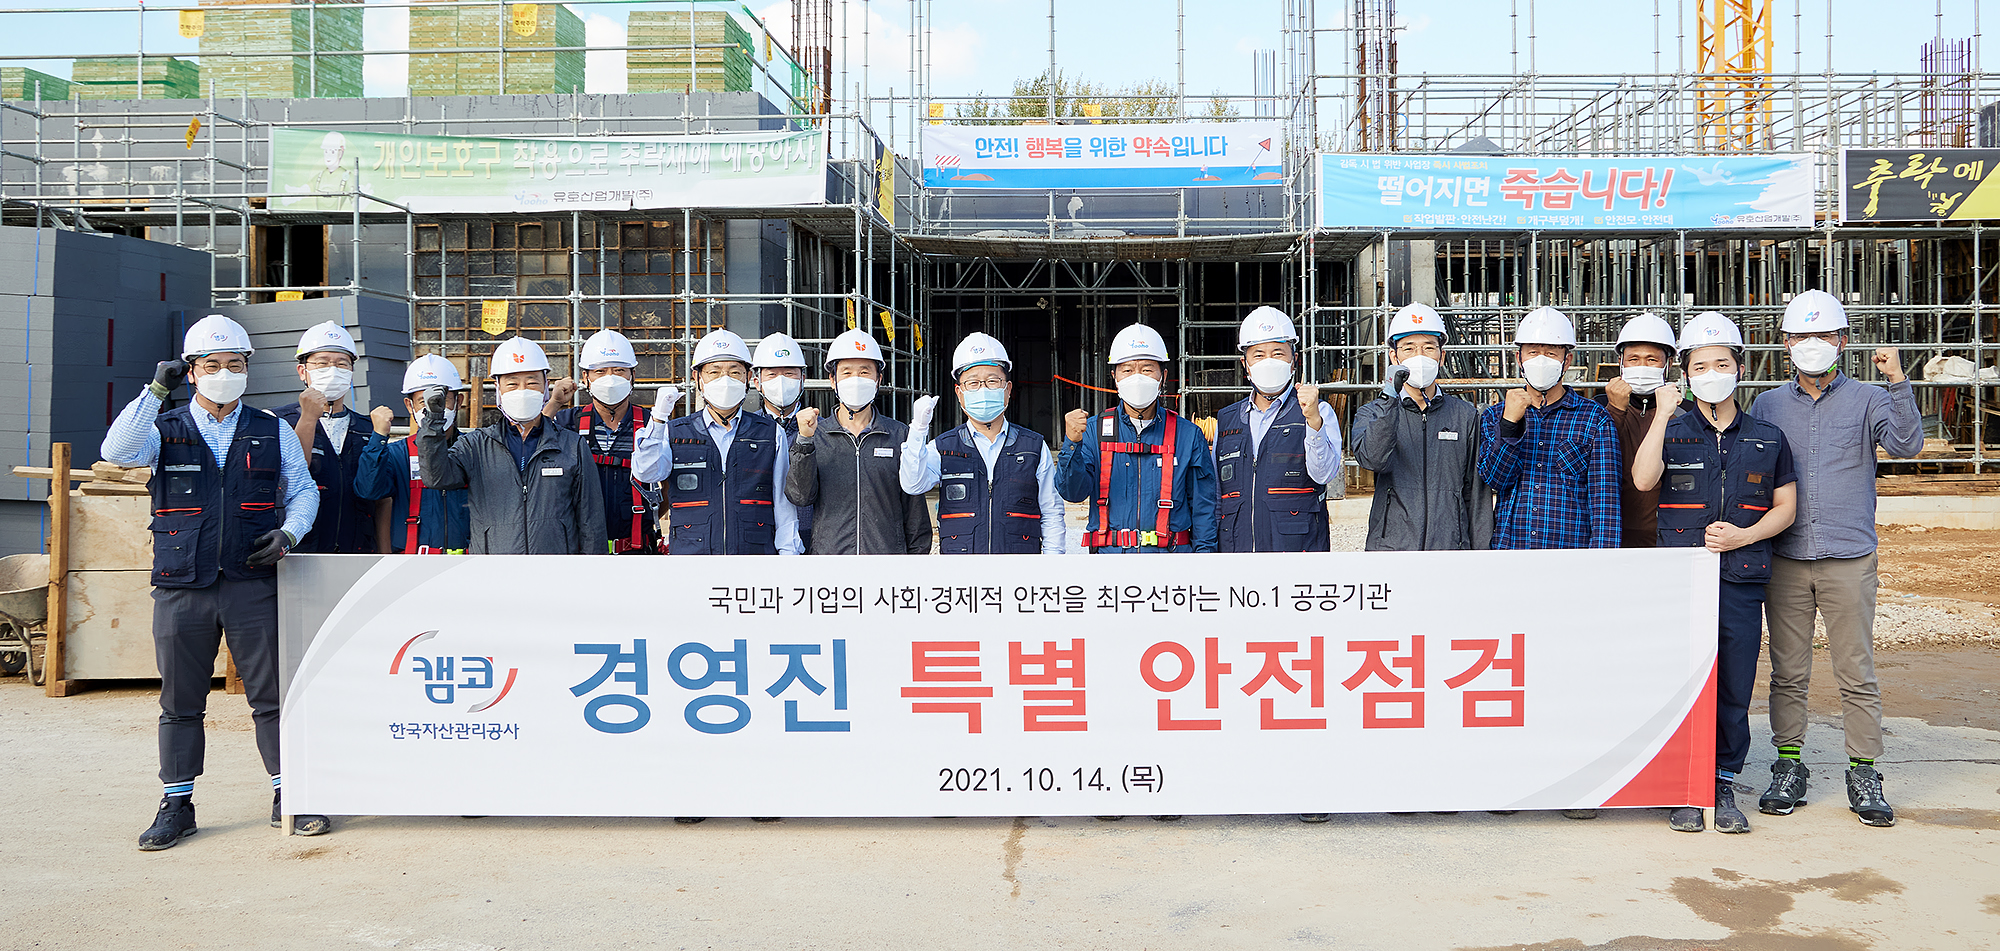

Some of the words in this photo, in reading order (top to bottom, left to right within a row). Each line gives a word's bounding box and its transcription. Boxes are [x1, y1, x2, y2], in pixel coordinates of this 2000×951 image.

[372, 140, 502, 179] 개인보호구
[512, 140, 610, 180] 착용으로
[974, 137, 1020, 159] 안전!
[1025, 137, 1083, 159] 행복을
[1088, 136, 1128, 158] 위한
[1133, 135, 1229, 158] 약속입니다
[1339, 158, 1358, 169] 감독
[1360, 159, 1370, 169] 시
[1371, 159, 1381, 169] 법
[1383, 159, 1402, 169] 위반
[1403, 159, 1431, 170] 사업장
[1433, 160, 1451, 170] 즉시
[553, 189, 654, 203] 유호산업개발(주)
[1376, 175, 1491, 208] 떨어지면
[1500, 168, 1674, 210] 죽습니다!
[1413, 213, 1507, 226] 작업발판·안전난간!
[1527, 214, 1584, 226] 개구부덮개!
[1604, 214, 1674, 226] 안전모·안전대
[708, 586, 784, 615] 국민과
[792, 586, 863, 614] 기업의
[874, 585, 1002, 614] 사회·경제적
[1014, 585, 1087, 613] 안전을
[1096, 584, 1221, 613] 최우선하는
[1229, 584, 1282, 609] No.1
[1290, 582, 1392, 612] 공공기관
[412, 655, 494, 704] 캠코
[569, 638, 851, 735] 경영진
[900, 638, 1088, 734] 특별
[1139, 633, 1526, 731] 안전점검
[389, 721, 520, 741] 한국자산관리공사
[939, 767, 1012, 792] 2021.
[1023, 767, 1062, 792] 10.
[1072, 767, 1111, 792] 14.
[1121, 764, 1164, 794] (목)
